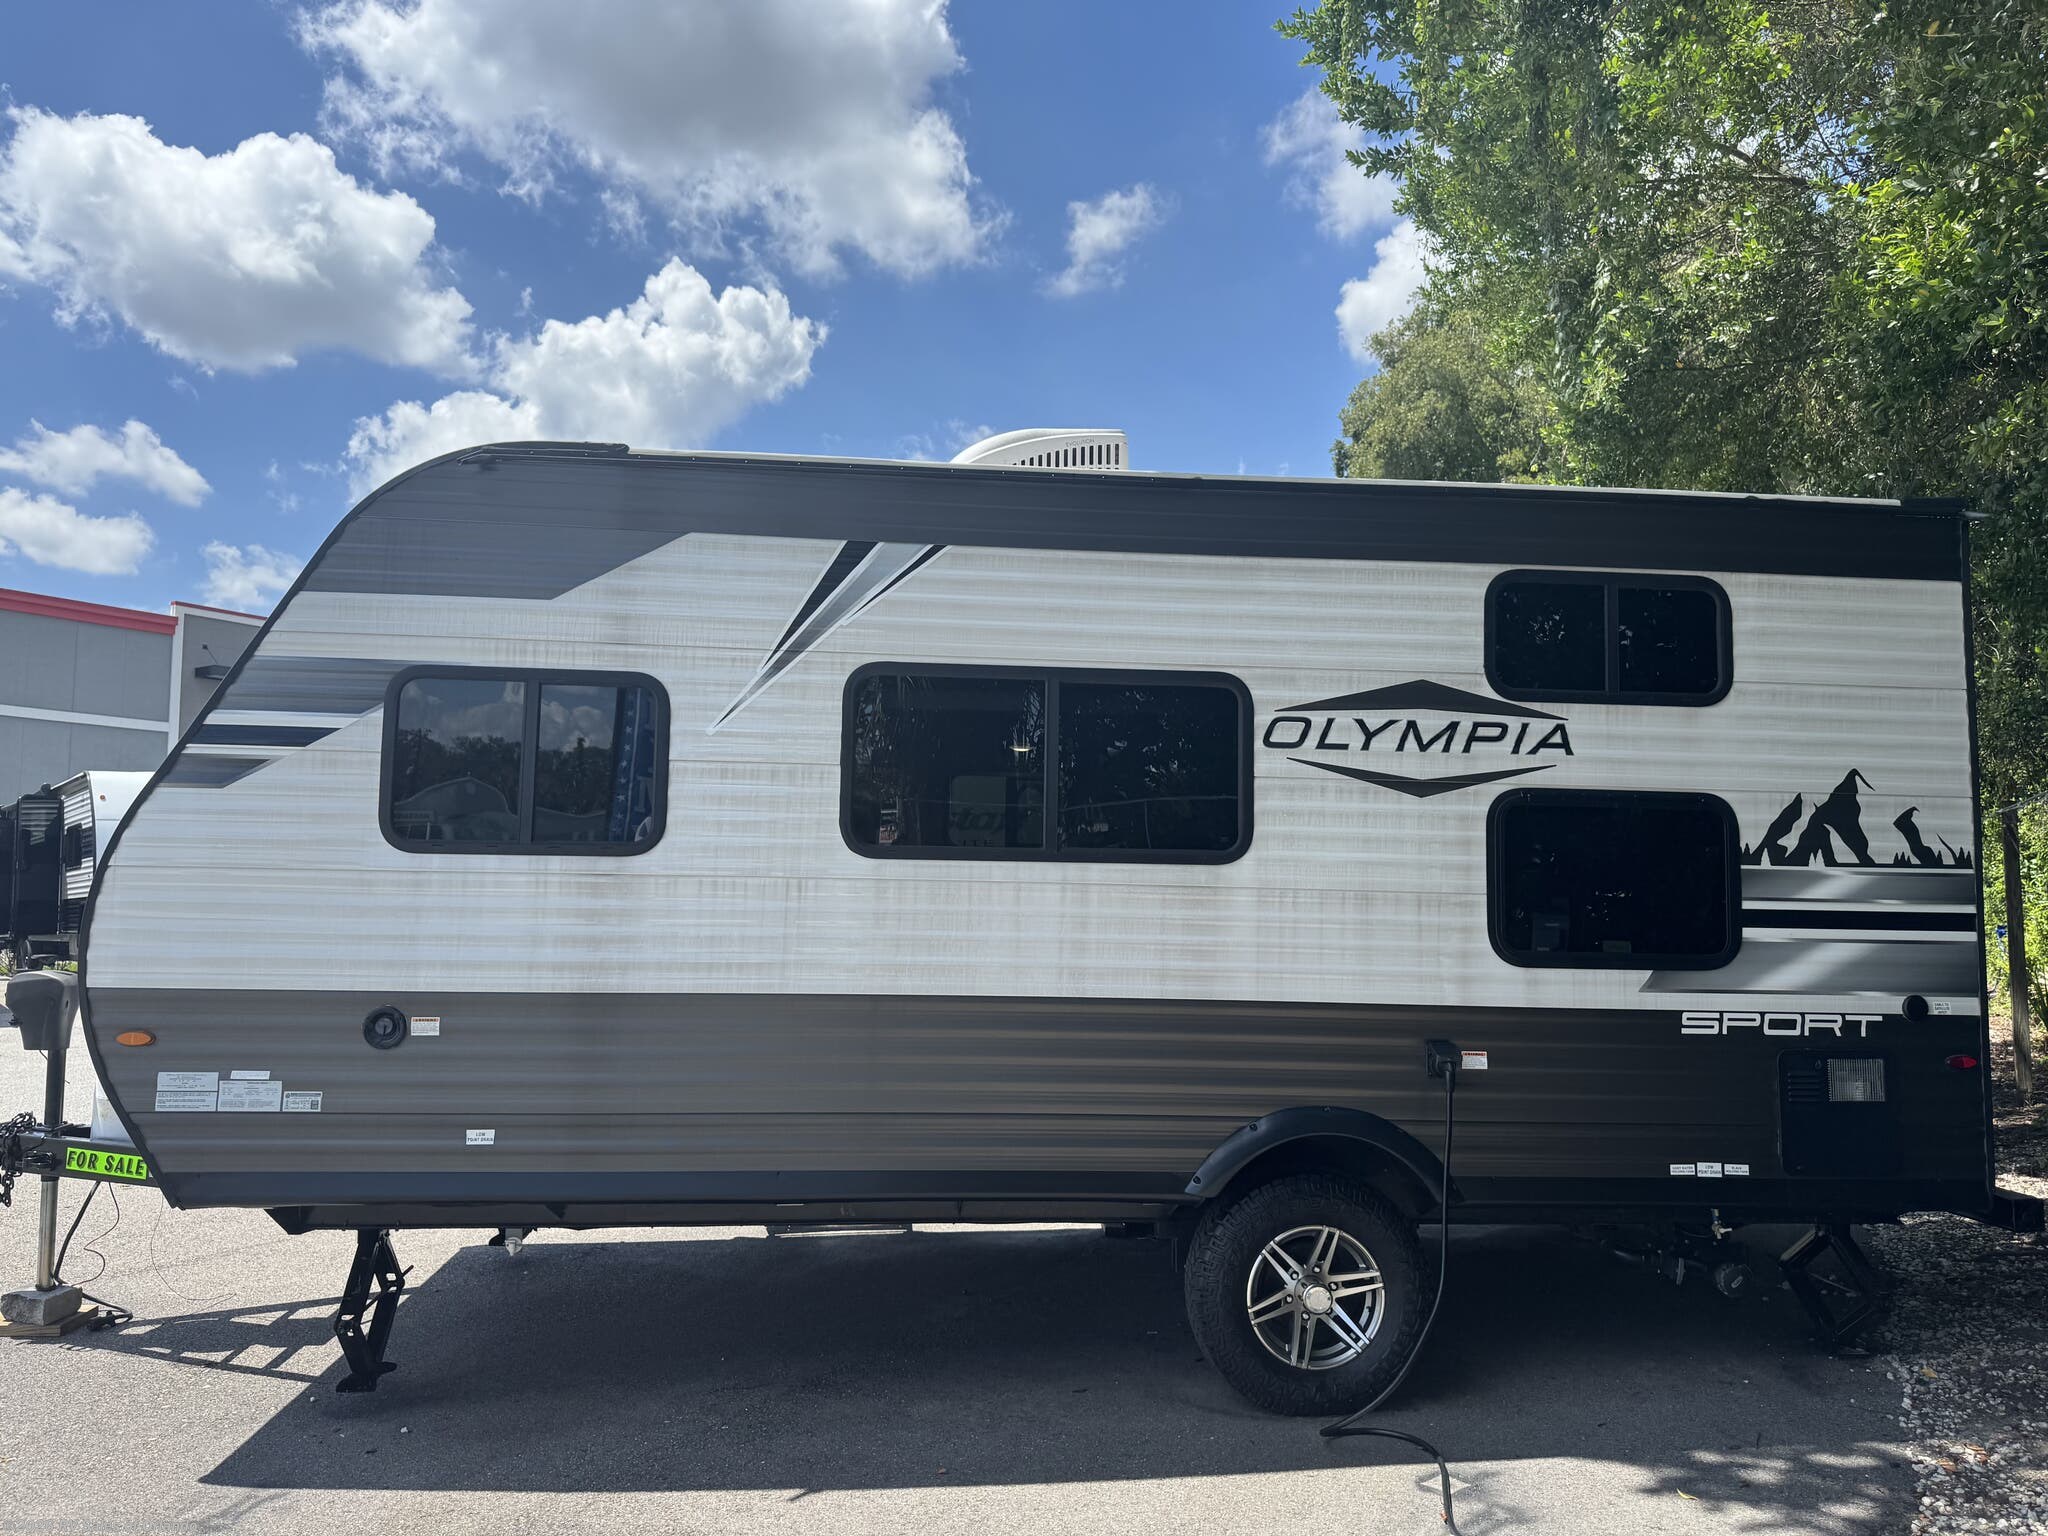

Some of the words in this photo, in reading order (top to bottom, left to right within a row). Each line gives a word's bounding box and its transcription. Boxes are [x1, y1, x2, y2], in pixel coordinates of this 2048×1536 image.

[1262, 716, 1574, 756] OLYMPIA
[1681, 1012, 1883, 1037] SPORT
[67, 1151, 98, 1170] FOR
[104, 1155, 144, 1176] SALE
